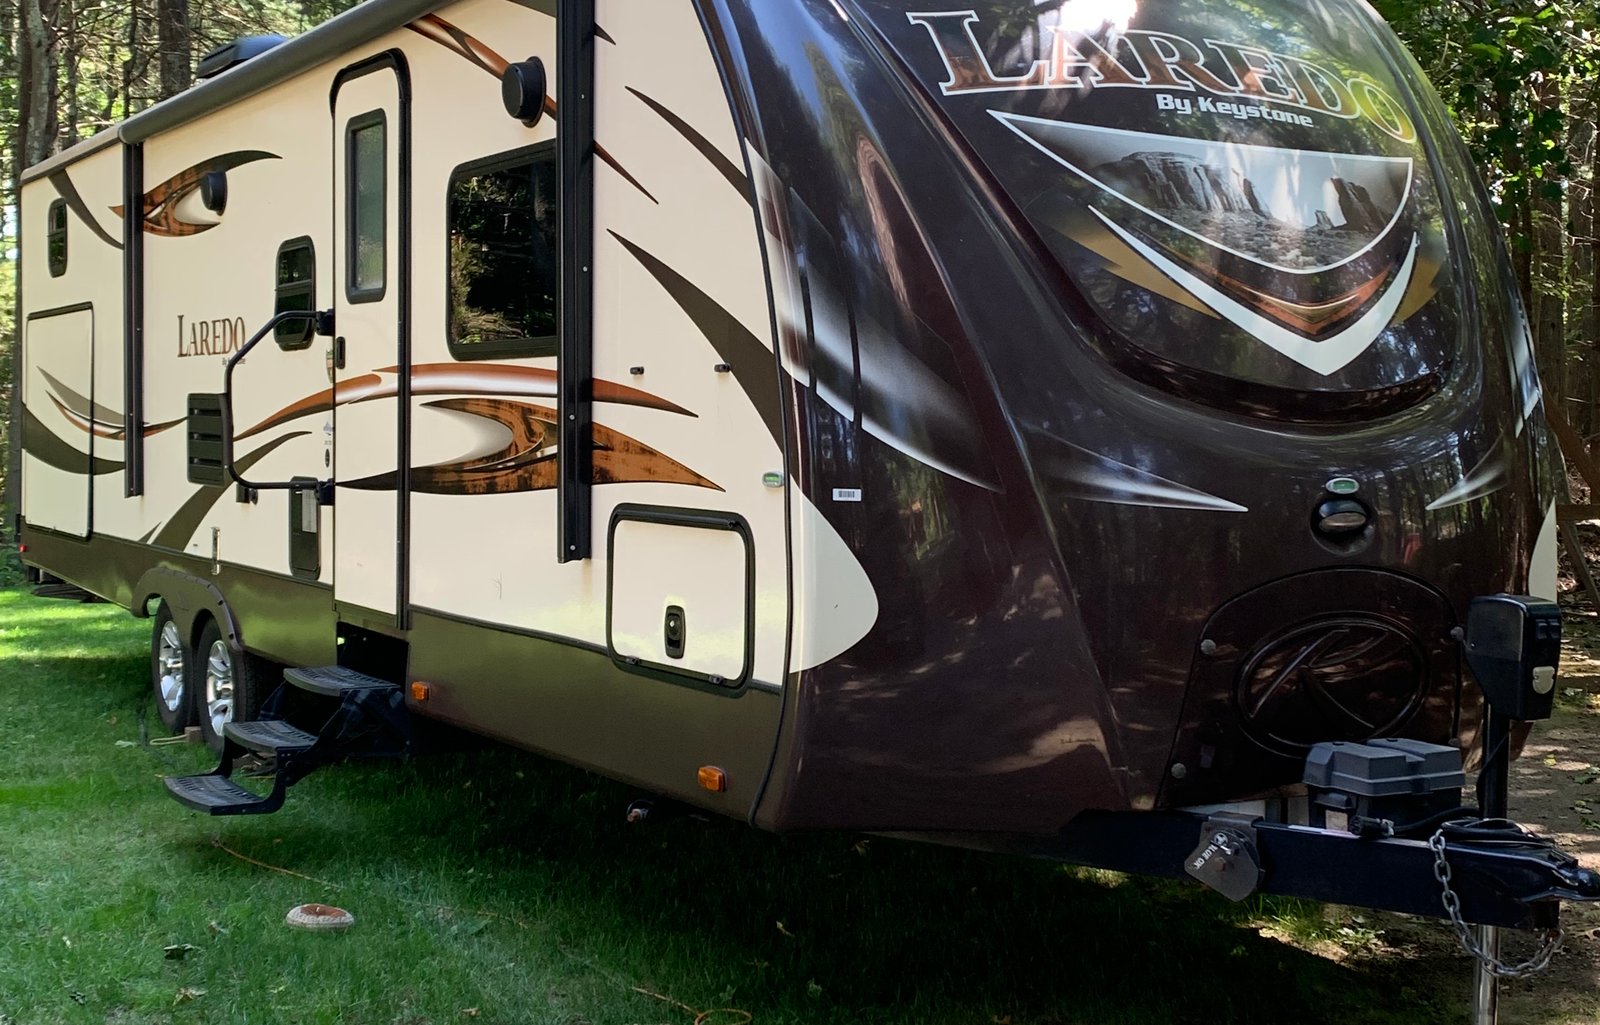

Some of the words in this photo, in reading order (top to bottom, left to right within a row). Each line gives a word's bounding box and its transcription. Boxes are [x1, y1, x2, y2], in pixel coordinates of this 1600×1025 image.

[907, 11, 1417, 144] LAREDO
[1155, 93, 1193, 115] By
[1197, 96, 1315, 128] Keystone
[177, 314, 246, 357] LAREDO
